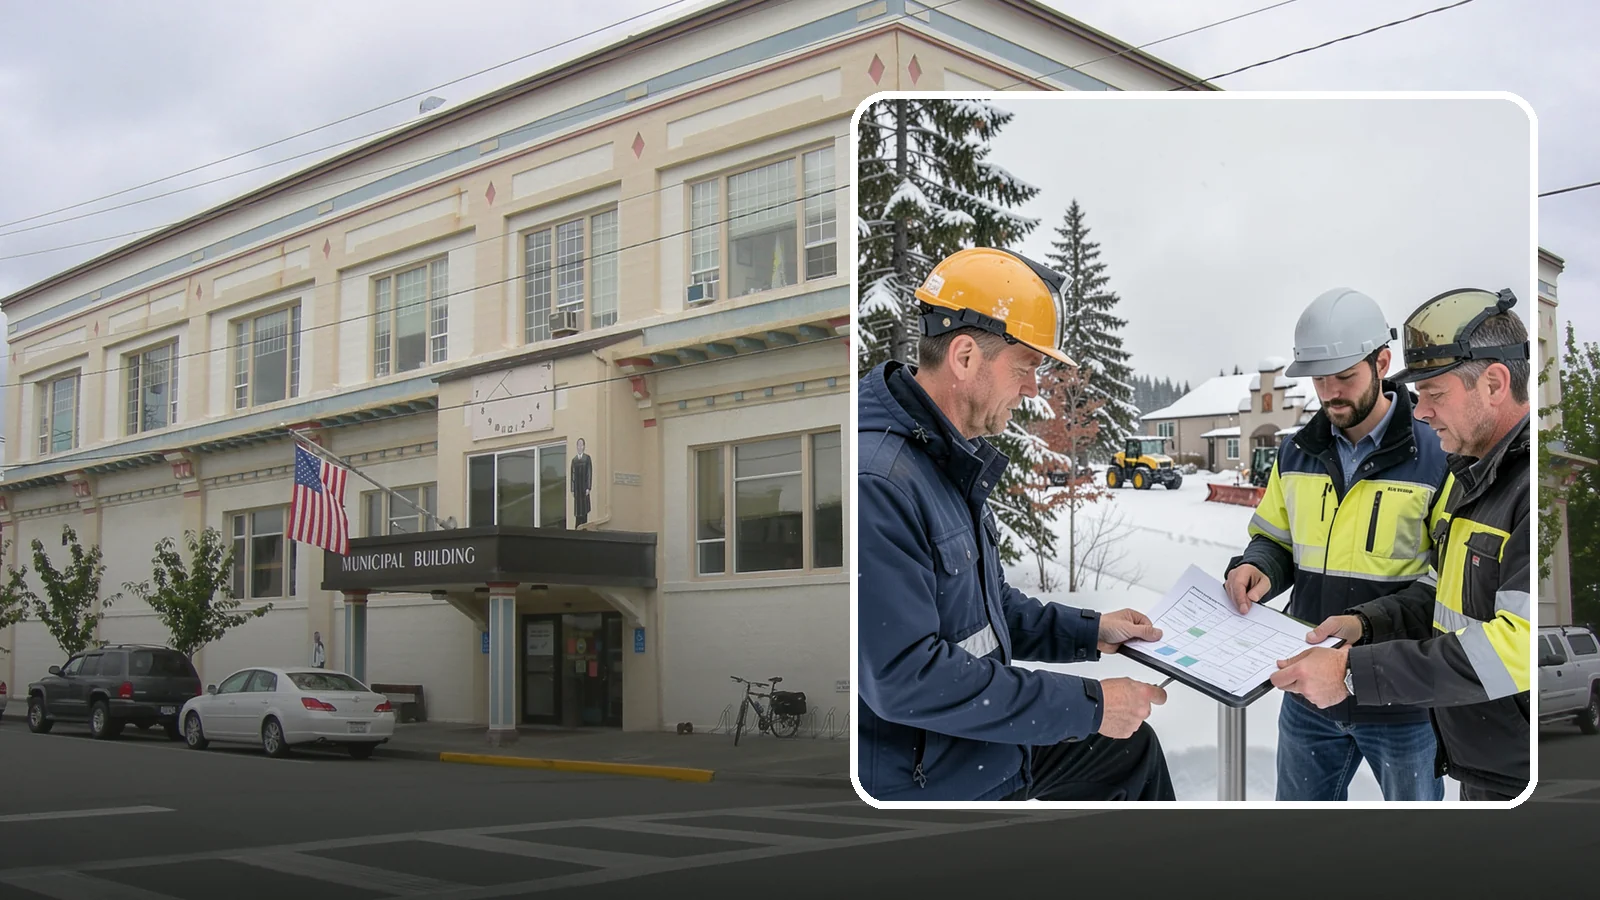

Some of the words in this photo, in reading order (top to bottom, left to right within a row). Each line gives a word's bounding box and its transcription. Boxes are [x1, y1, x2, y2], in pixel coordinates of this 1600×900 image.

[481, 407, 485, 415] 8
[488, 418, 492, 426] 9
[495, 424, 500, 432] 10
[507, 425, 513, 433] 12
[521, 420, 525, 428] 2
[529, 414, 533, 422] 3
[536, 402, 540, 410] 4
[342, 552, 405, 572] MUNICIPAL
[414, 546, 475, 567] BUILDING
